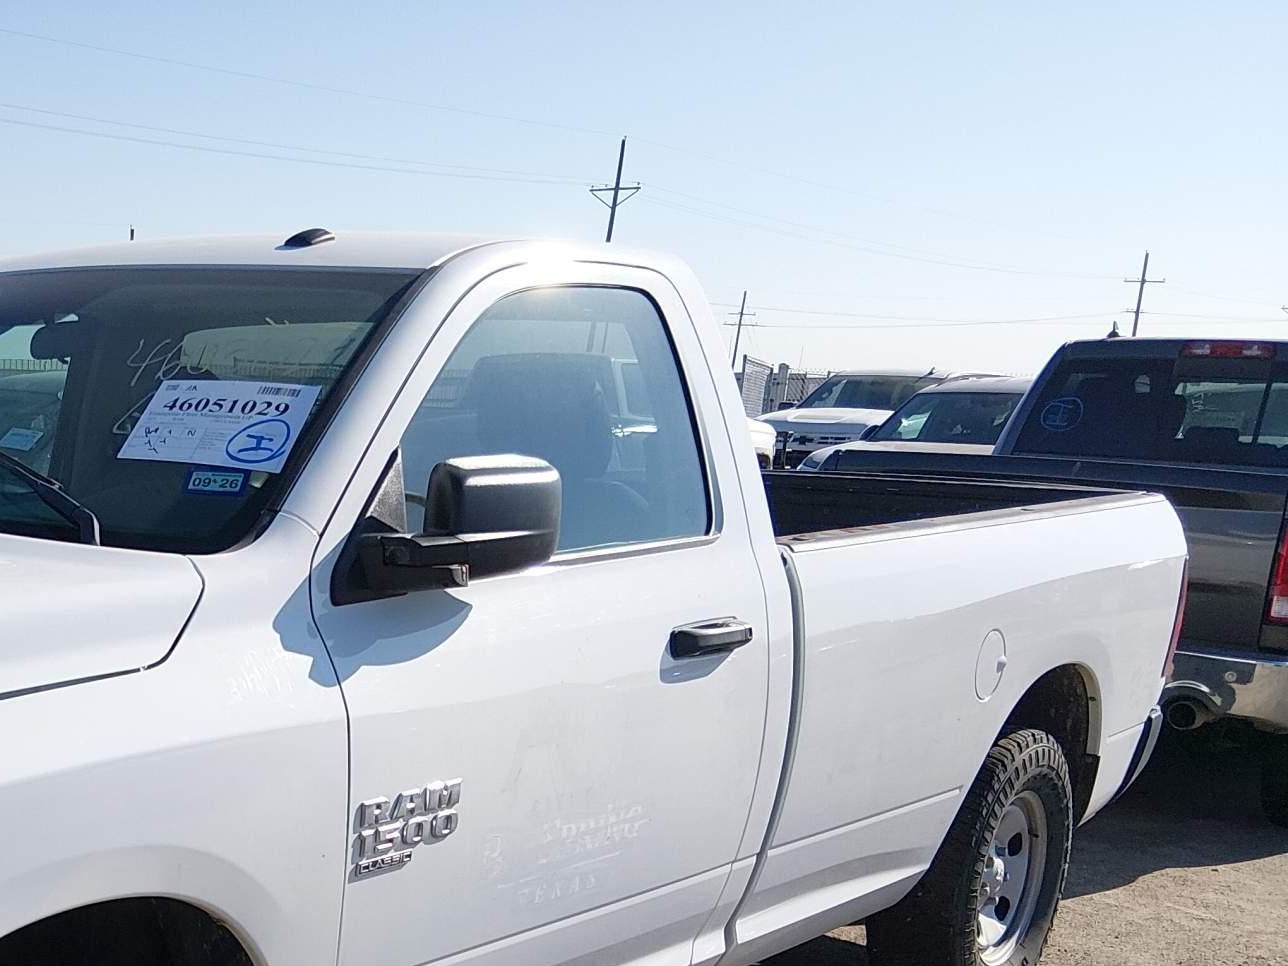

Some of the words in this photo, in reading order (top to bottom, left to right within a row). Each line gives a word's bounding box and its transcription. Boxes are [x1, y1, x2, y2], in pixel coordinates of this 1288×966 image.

[162, 396, 291, 418] 46051029
[192, 477, 212, 488] 09
[218, 478, 240, 489] 26
[356, 777, 463, 830] RAM
[355, 808, 459, 860] 1500
[358, 850, 412, 875] CLASSIC
